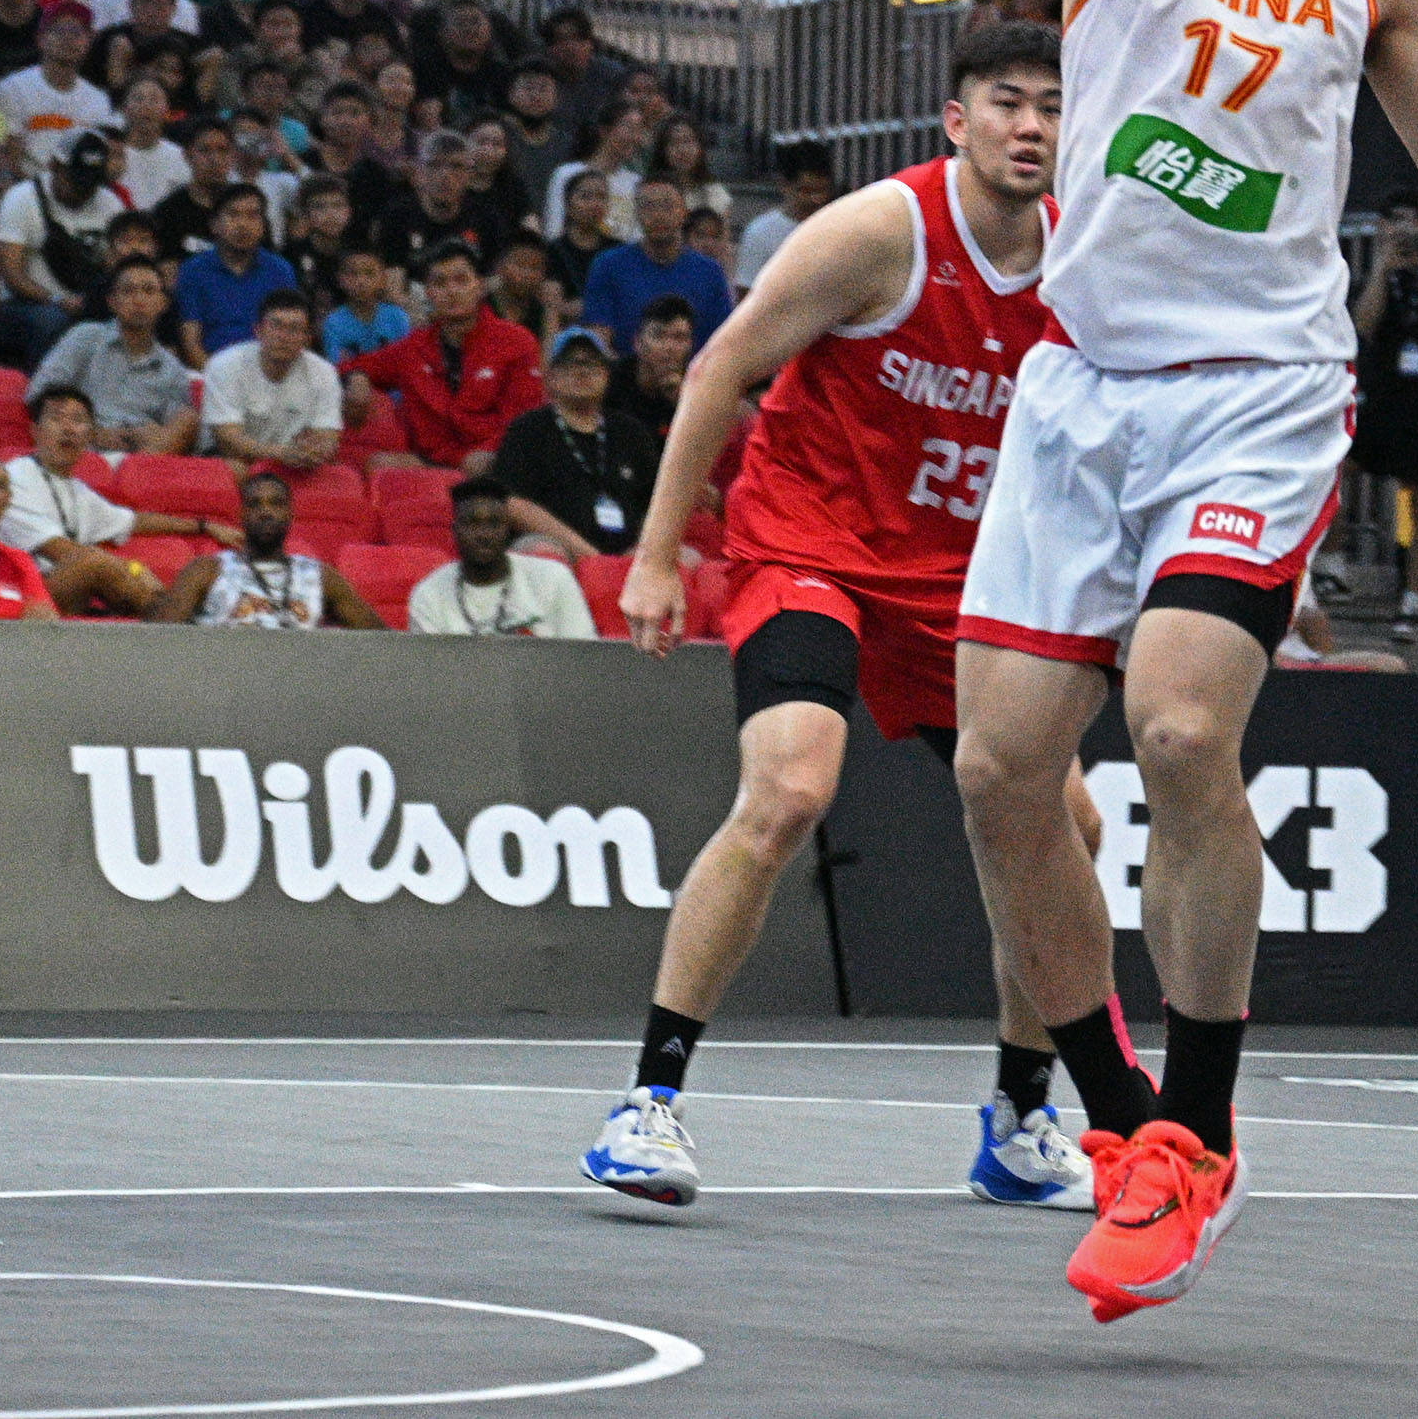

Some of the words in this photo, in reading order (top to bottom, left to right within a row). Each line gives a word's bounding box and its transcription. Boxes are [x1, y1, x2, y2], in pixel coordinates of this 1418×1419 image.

[1183, 19, 1283, 114] 17
[907, 438, 1000, 521] 23
[1198, 508, 1255, 539] CHN
[70, 745, 673, 909] Wilson
